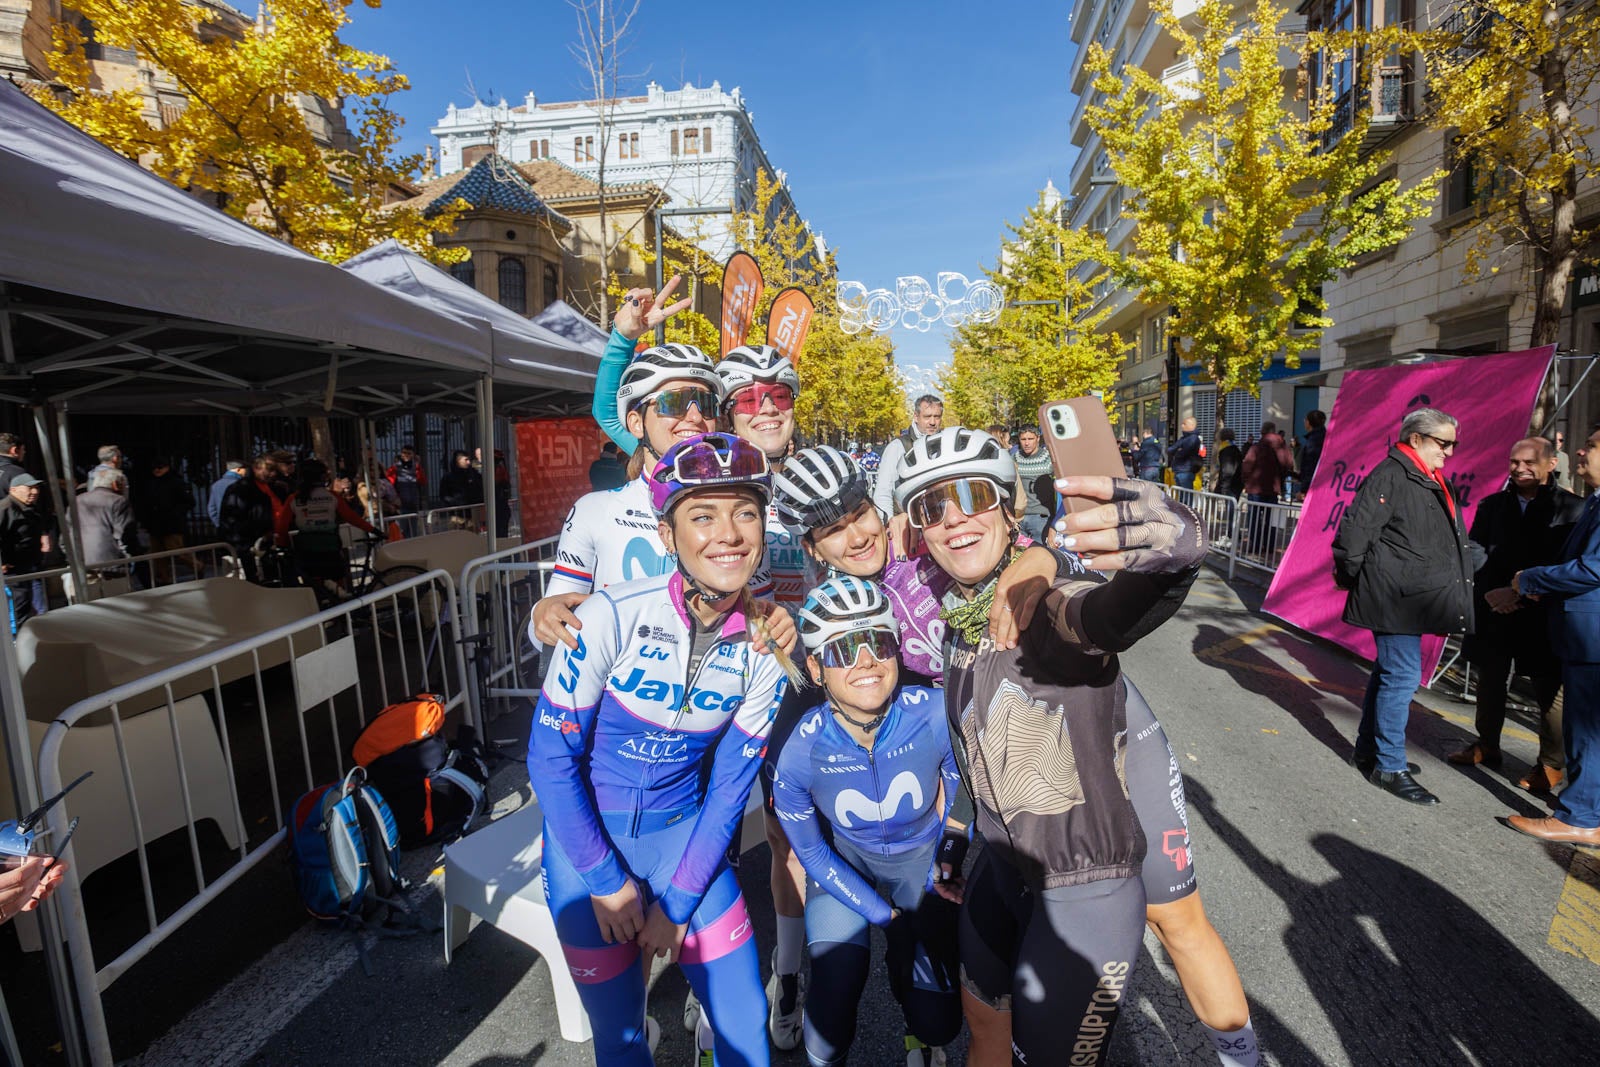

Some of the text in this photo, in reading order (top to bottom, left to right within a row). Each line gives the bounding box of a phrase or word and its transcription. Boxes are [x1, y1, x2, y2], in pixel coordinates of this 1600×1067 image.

[1579, 275, 1600, 296] M
[537, 434, 583, 468] HSN
[768, 548, 804, 564] EAM
[639, 644, 670, 661] Liv
[610, 667, 746, 712] Jayco
[820, 764, 868, 775] CANYON
